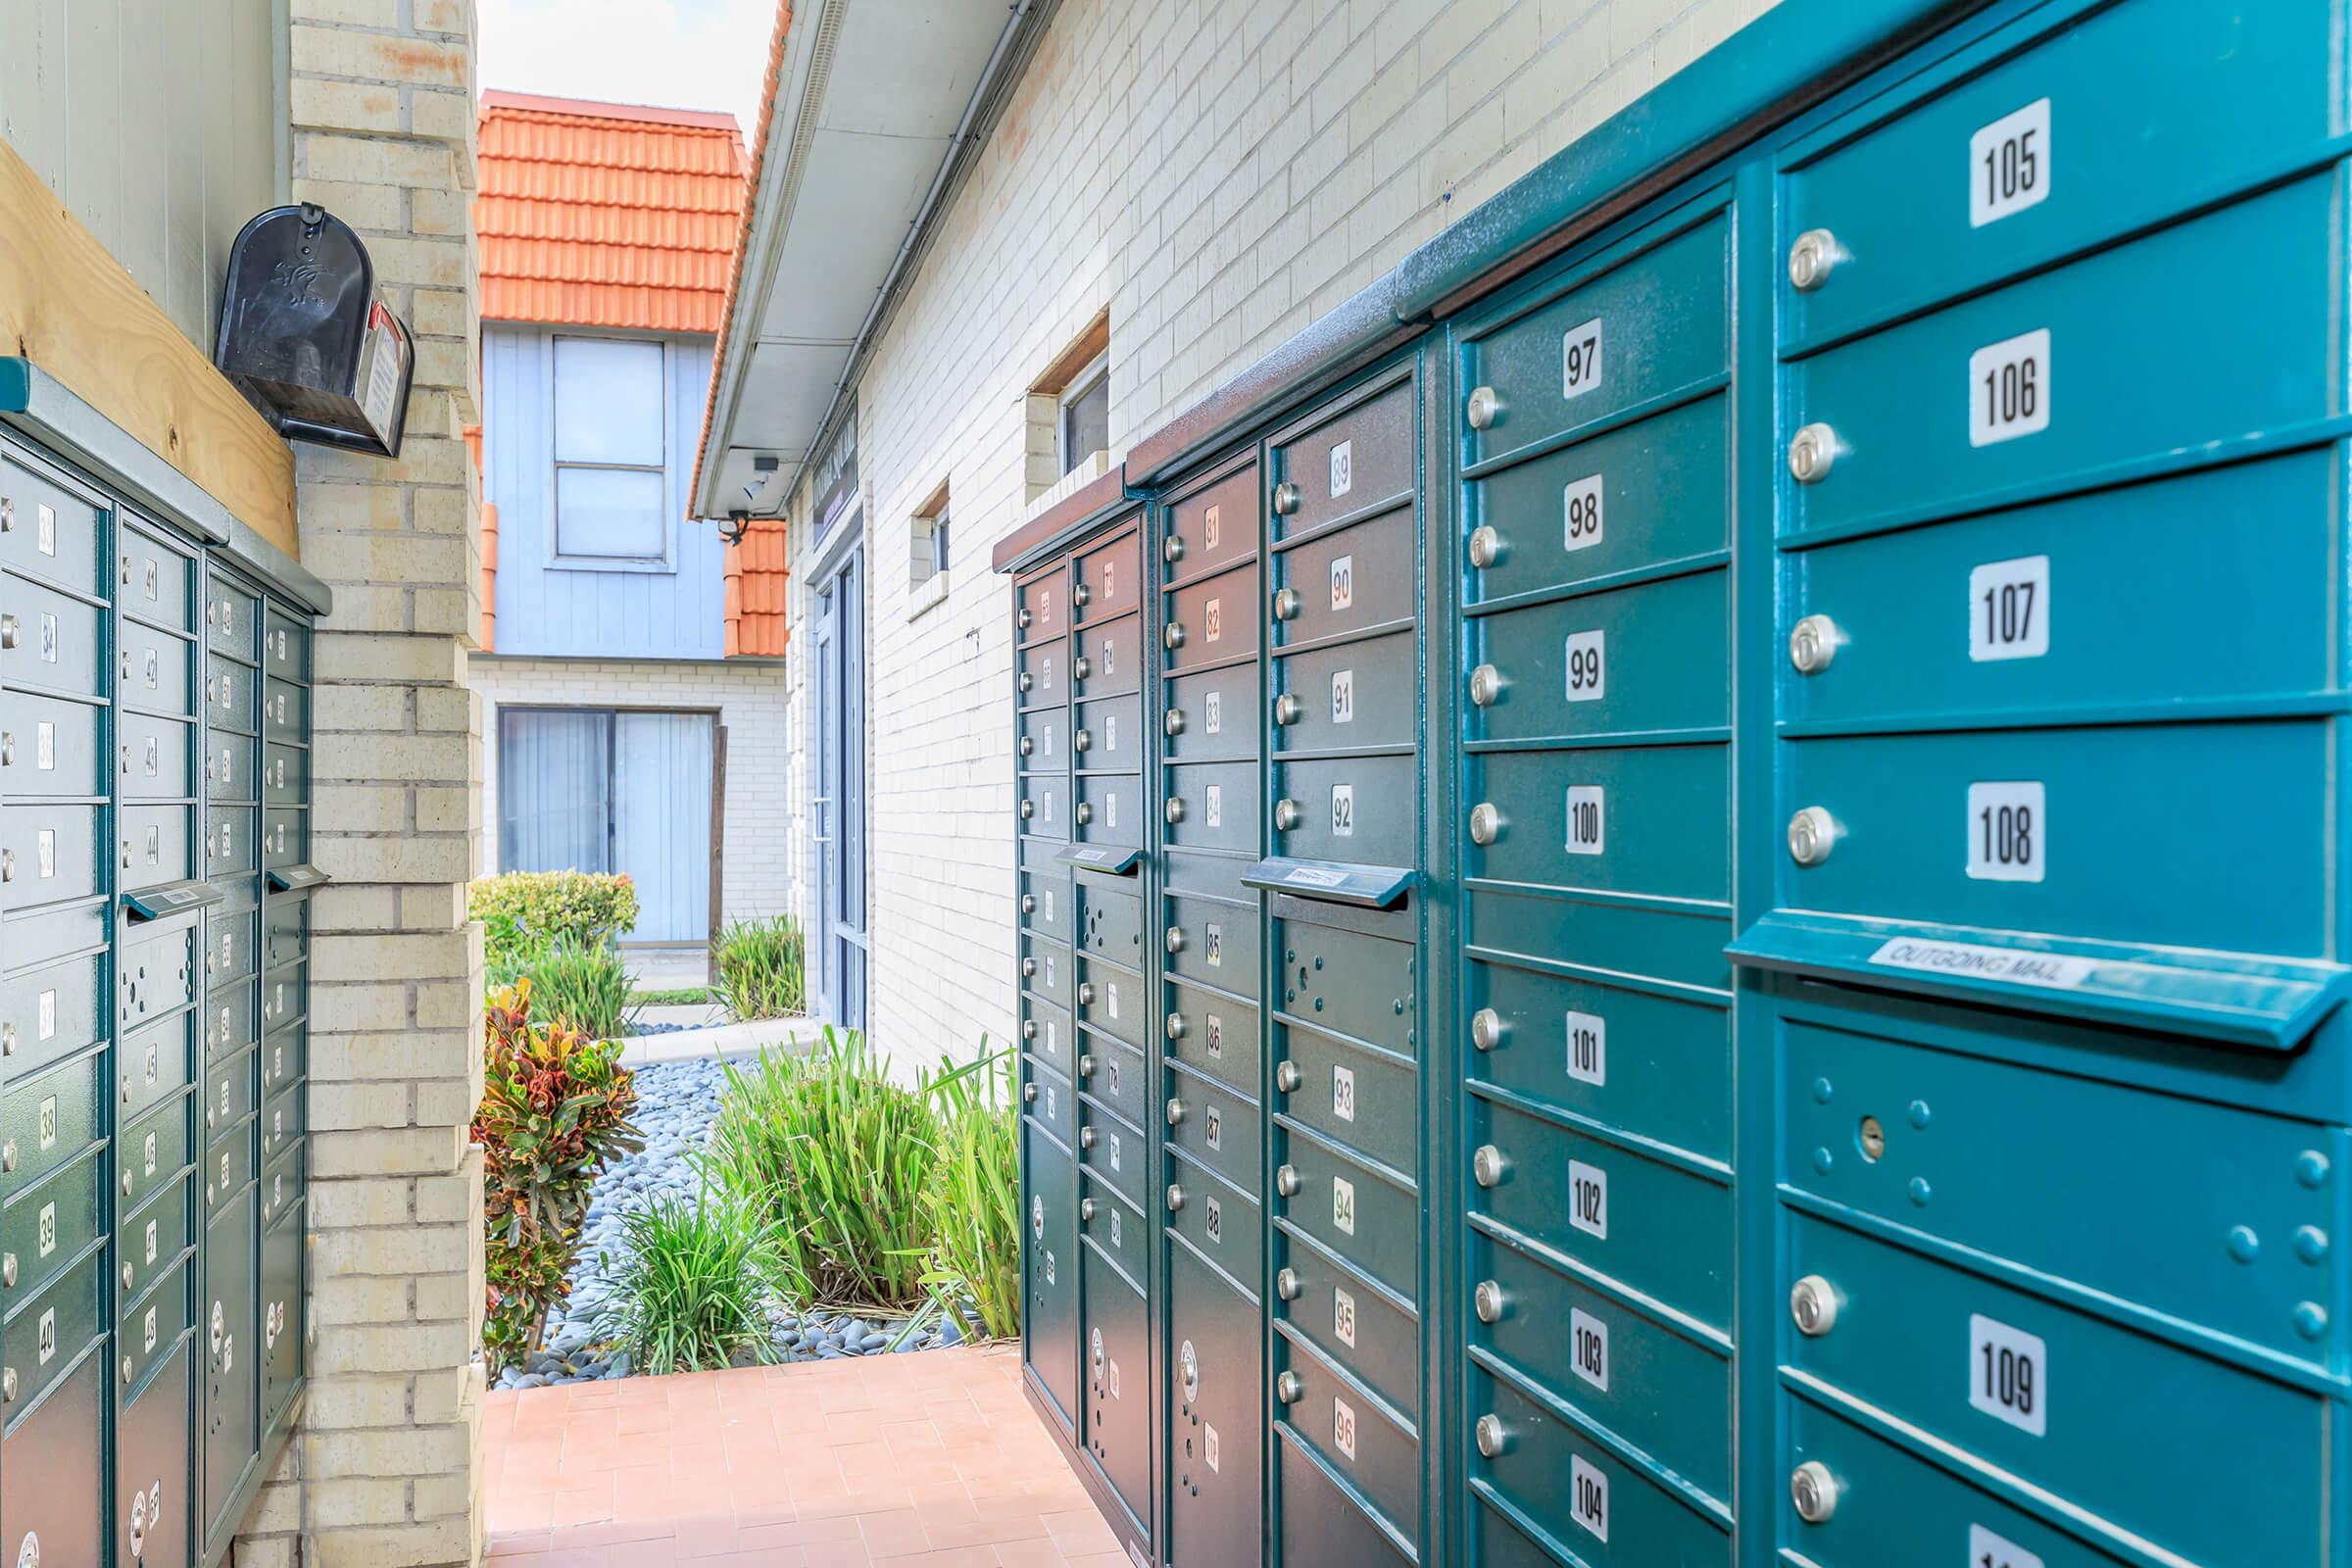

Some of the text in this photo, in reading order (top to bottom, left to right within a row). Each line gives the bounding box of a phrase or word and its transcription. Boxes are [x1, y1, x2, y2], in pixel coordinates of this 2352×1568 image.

[1984, 127, 2036, 207] 105
[1567, 336, 1596, 387] 97
[1984, 357, 2036, 427] 106
[1333, 454, 1348, 488] 89
[1207, 516, 1217, 543] 81
[1569, 492, 1597, 539] 98
[146, 567, 155, 595] 41
[1105, 569, 1113, 592] 73
[1333, 568, 1349, 602] 90
[1207, 609, 1218, 636] 82
[1984, 581, 2035, 645] 107
[42, 623, 54, 655] 34
[146, 657, 156, 683] 42
[1104, 647, 1113, 668] 74
[1570, 647, 1598, 690] 99
[1206, 701, 1218, 727] 83
[1335, 681, 1349, 714] 91
[1207, 795, 1218, 821] 84
[1334, 797, 1350, 828] 92
[1572, 802, 1598, 844] 100
[147, 834, 157, 859] 44
[1981, 806, 2031, 864] 108
[1208, 932, 1220, 960] 85
[1888, 944, 2064, 981] OUTGOING MAIL
[1208, 1024, 1220, 1052] 86
[1573, 1028, 1596, 1073] 101
[146, 1054, 155, 1080] 45
[1109, 1065, 1118, 1090] 78
[1336, 1078, 1351, 1111] 93
[41, 1108, 54, 1141] 38
[1207, 1114, 1219, 1143] 87
[145, 1142, 155, 1168] 46
[1336, 1190, 1351, 1225] 94
[1575, 1177, 1601, 1226] 102
[40, 1214, 54, 1249] 39
[1207, 1206, 1219, 1236] 88
[146, 1229, 156, 1256] 47
[1337, 1300, 1352, 1338] 95
[40, 1319, 54, 1353] 40
[1576, 1326, 1602, 1377] 103
[1982, 1342, 2034, 1416] 109
[1337, 1410, 1352, 1449] 96
[1577, 1473, 1603, 1528] 104
